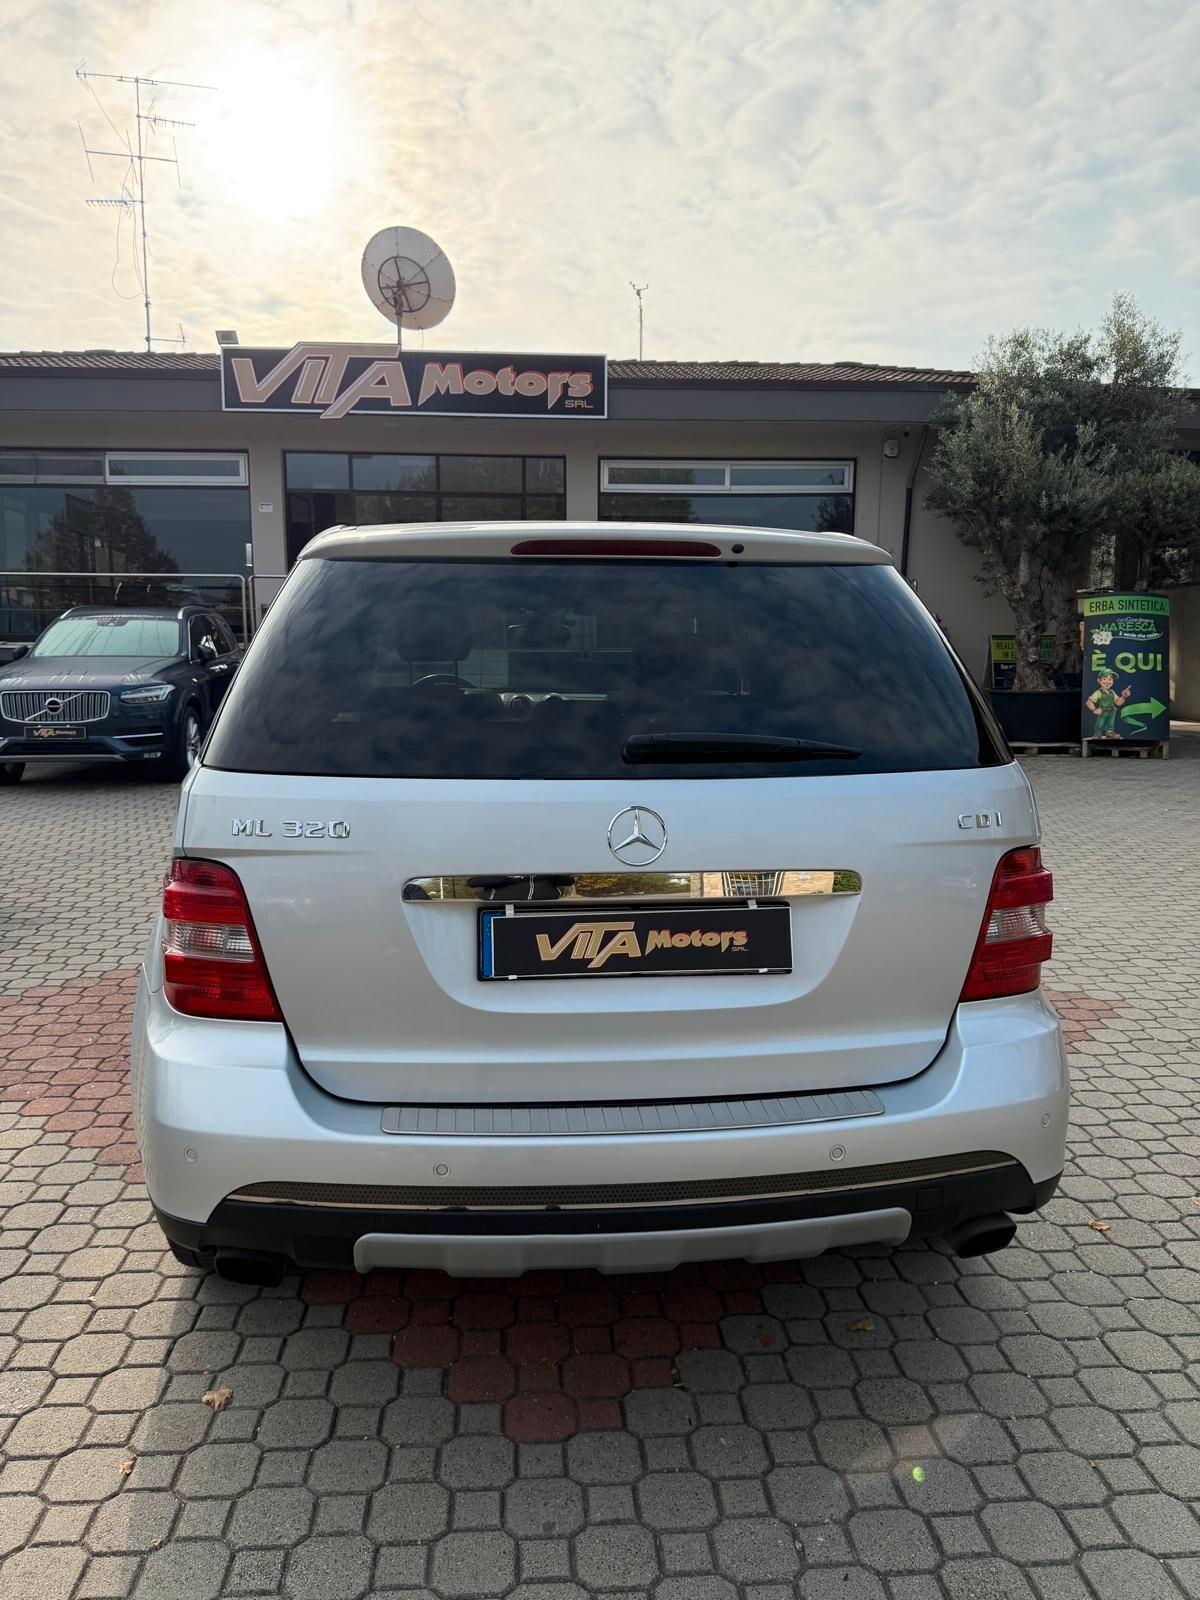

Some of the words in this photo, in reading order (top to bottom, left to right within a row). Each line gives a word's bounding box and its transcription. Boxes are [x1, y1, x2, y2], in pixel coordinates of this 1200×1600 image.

[231, 341, 412, 419] VITA
[418, 362, 594, 410] Motors
[564, 399, 594, 409] SRL
[1089, 600, 1115, 613] ERBA
[1118, 599, 1165, 612] SINTETICA
[1099, 622, 1156, 633] MARESCA
[1091, 649, 1106, 672] È
[1115, 651, 1163, 674] QUI
[231, 817, 272, 838] ML
[282, 819, 351, 840] 320
[957, 810, 1003, 830] CDI
[535, 920, 642, 968] VITA
[645, 928, 748, 956] Motors
